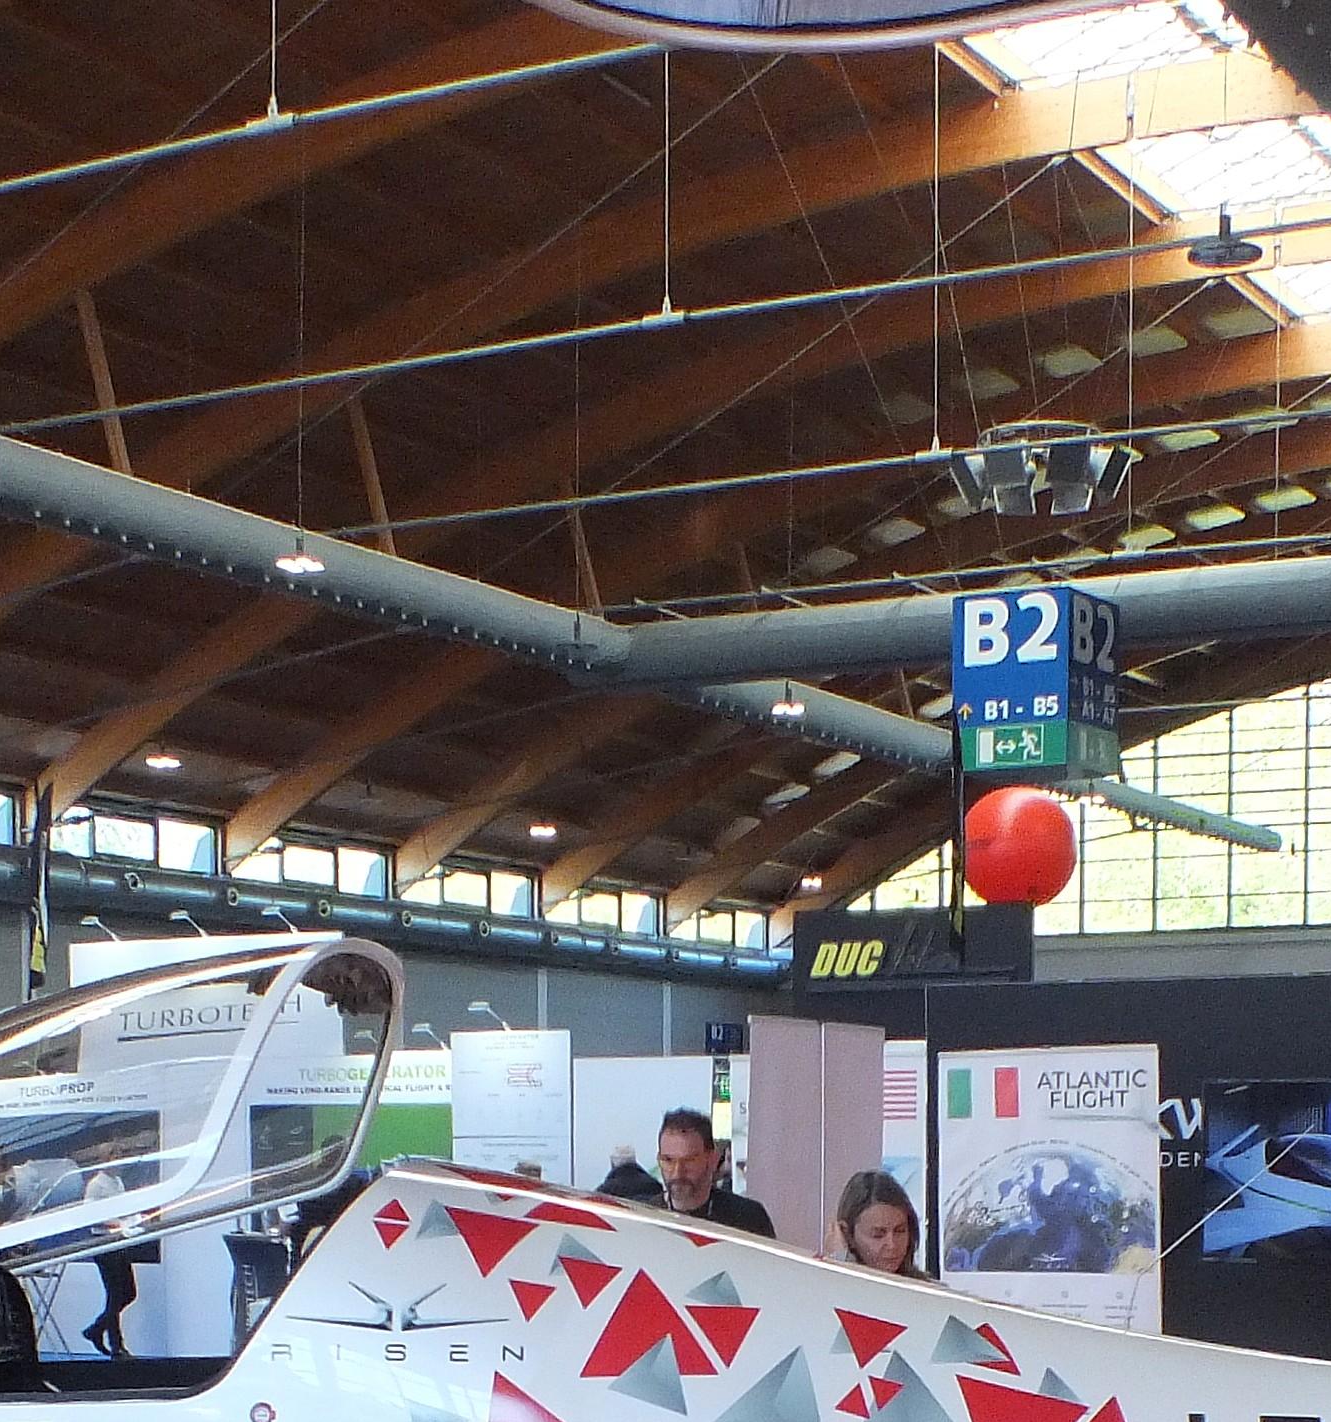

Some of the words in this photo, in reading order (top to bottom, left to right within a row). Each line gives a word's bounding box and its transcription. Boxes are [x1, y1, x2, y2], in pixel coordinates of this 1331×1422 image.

[963, 591, 1059, 668] B2
[1072, 595, 1115, 673] B2
[984, 699, 1009, 721] B1
[1033, 695, 1059, 717] B5
[809, 939, 885, 978] DUC
[119, 993, 302, 1031] TURBOTEH
[299, 1064, 446, 1082] TURBOGERATOR
[1037, 1069, 1148, 1090] ATLANTIC
[19, 1081, 95, 1098] TURBOPROP
[1049, 1090, 1129, 1110] FLIGHT
[271, 1343, 524, 1362] RISEN
